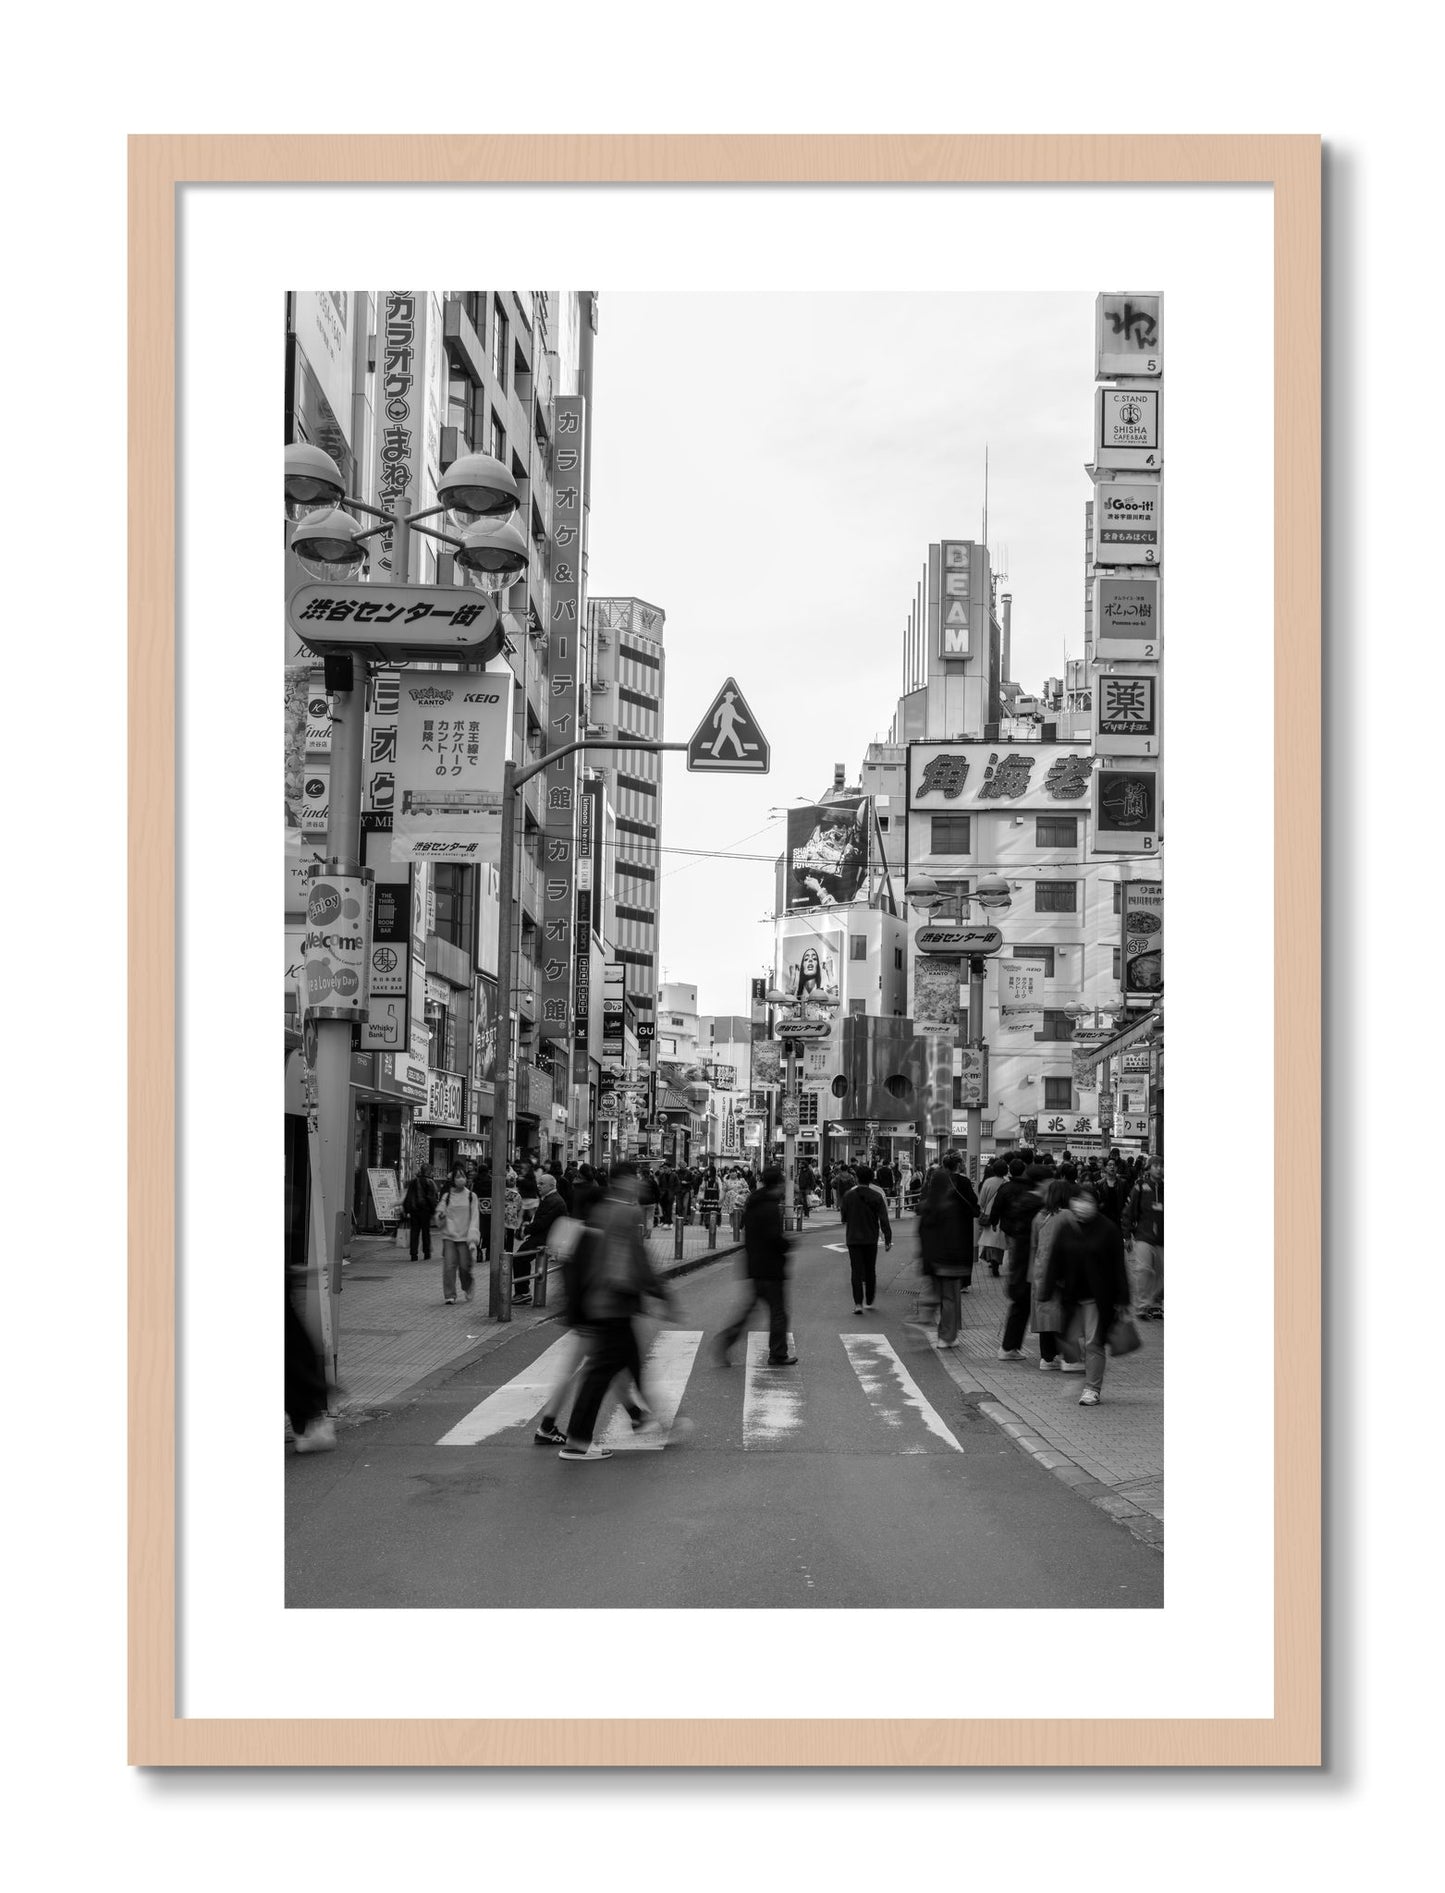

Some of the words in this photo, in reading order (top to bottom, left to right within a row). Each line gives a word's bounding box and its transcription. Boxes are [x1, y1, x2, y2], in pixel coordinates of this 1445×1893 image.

[384, 296, 415, 399] カラオケ
[1147, 360, 1156, 371] 5
[1113, 426, 1147, 434] SHISHA
[1146, 454, 1155, 466] 4
[1112, 498, 1153, 511] Goo-it!
[1103, 532, 1155, 541] 全身もみほぐし
[1145, 549, 1154, 561] 3
[945, 544, 970, 652] BEAM
[299, 598, 486, 626] 渋谷センター街
[1145, 645, 1154, 657] 2
[463, 693, 500, 704] KEIO
[1107, 681, 1145, 719] 薬
[421, 720, 434, 752] 冒険へ
[436, 721, 449, 776] カントーの
[467, 721, 480, 766] 京王線で
[1145, 741, 1151, 752] 1
[915, 753, 1094, 799] 角海老
[1102, 782, 1149, 819] 一蘭
[582, 798, 590, 825] kimono
[412, 842, 479, 852] 渋谷センター街
[1144, 837, 1153, 849] B
[311, 894, 338, 920] Enjoy
[305, 931, 363, 950] Welcome
[920, 932, 998, 943] 渋谷センター街
[1127, 940, 1148, 954] 6F
[369, 1024, 394, 1032] Whisky
[638, 1026, 654, 1035] GU
[1048, 1116, 1092, 1132] 兆楽
